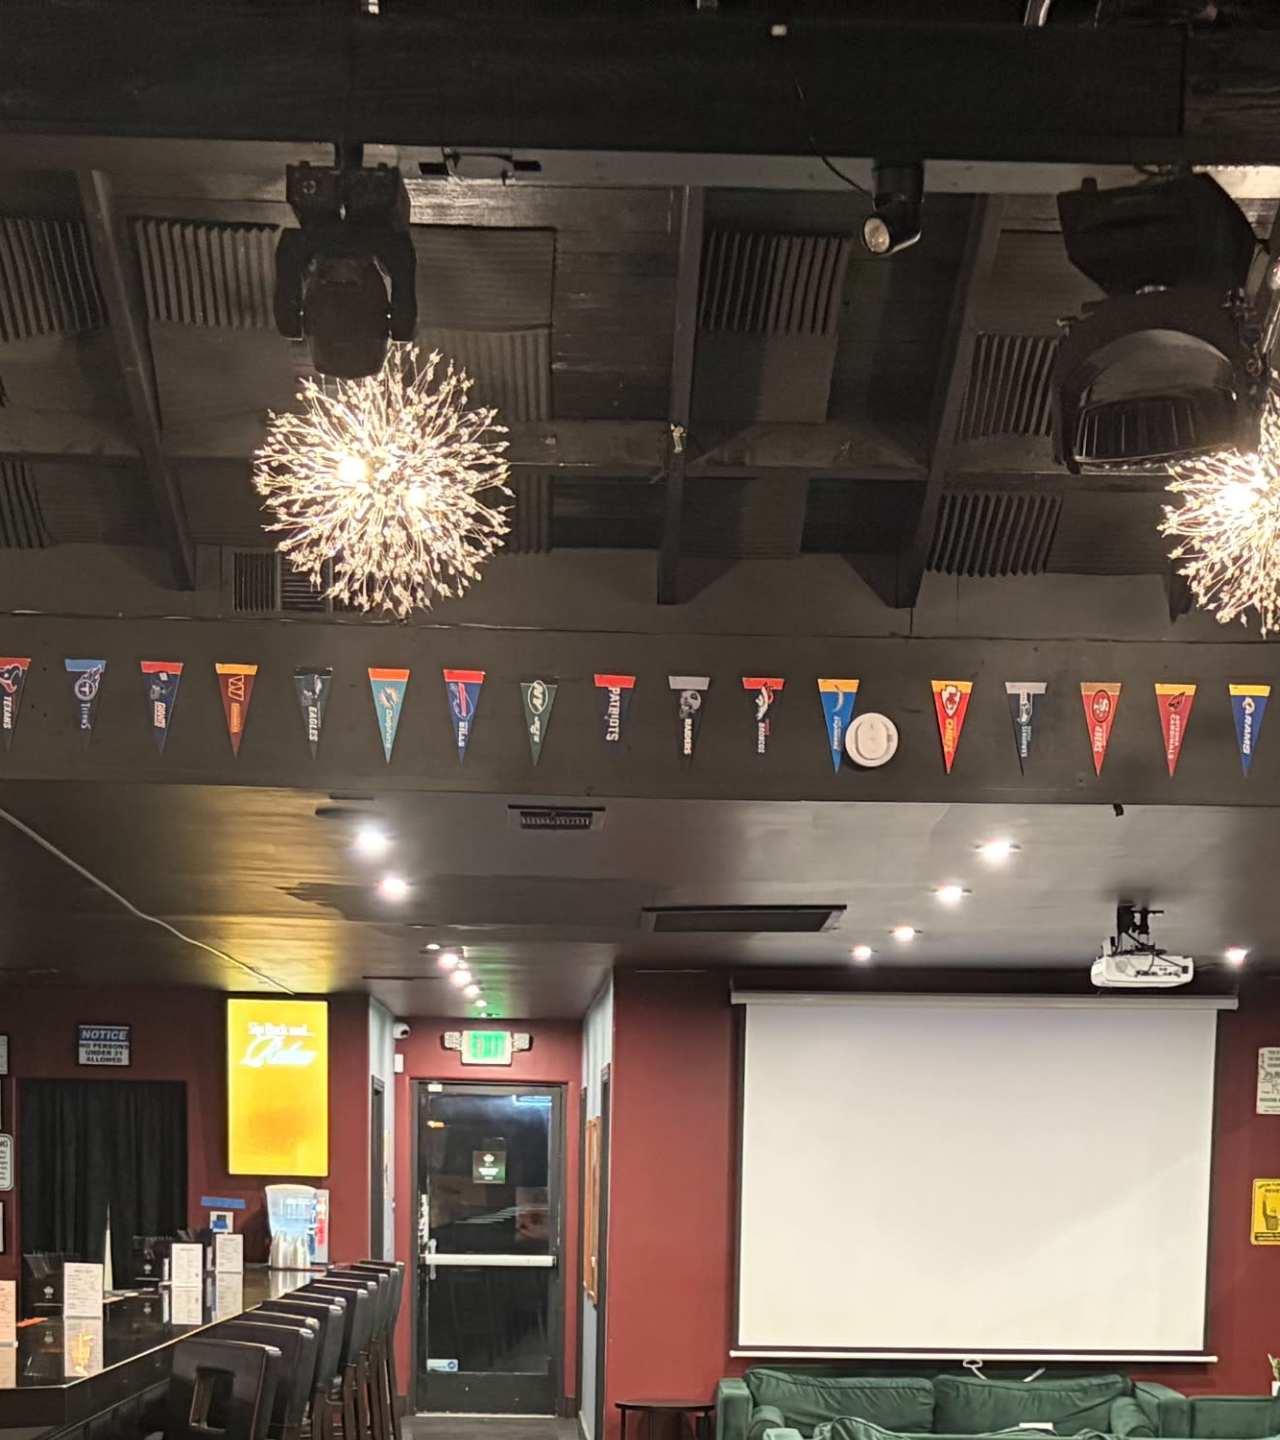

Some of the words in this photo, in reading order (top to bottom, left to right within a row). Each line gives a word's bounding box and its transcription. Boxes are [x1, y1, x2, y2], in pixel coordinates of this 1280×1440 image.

[2, 695, 13, 730] TEXANS
[308, 706, 319, 742] EAGLES
[605, 687, 621, 742] PATRIOTS
[1242, 714, 1253, 754] RAMS
[81, 1029, 129, 1041] NOTICE
